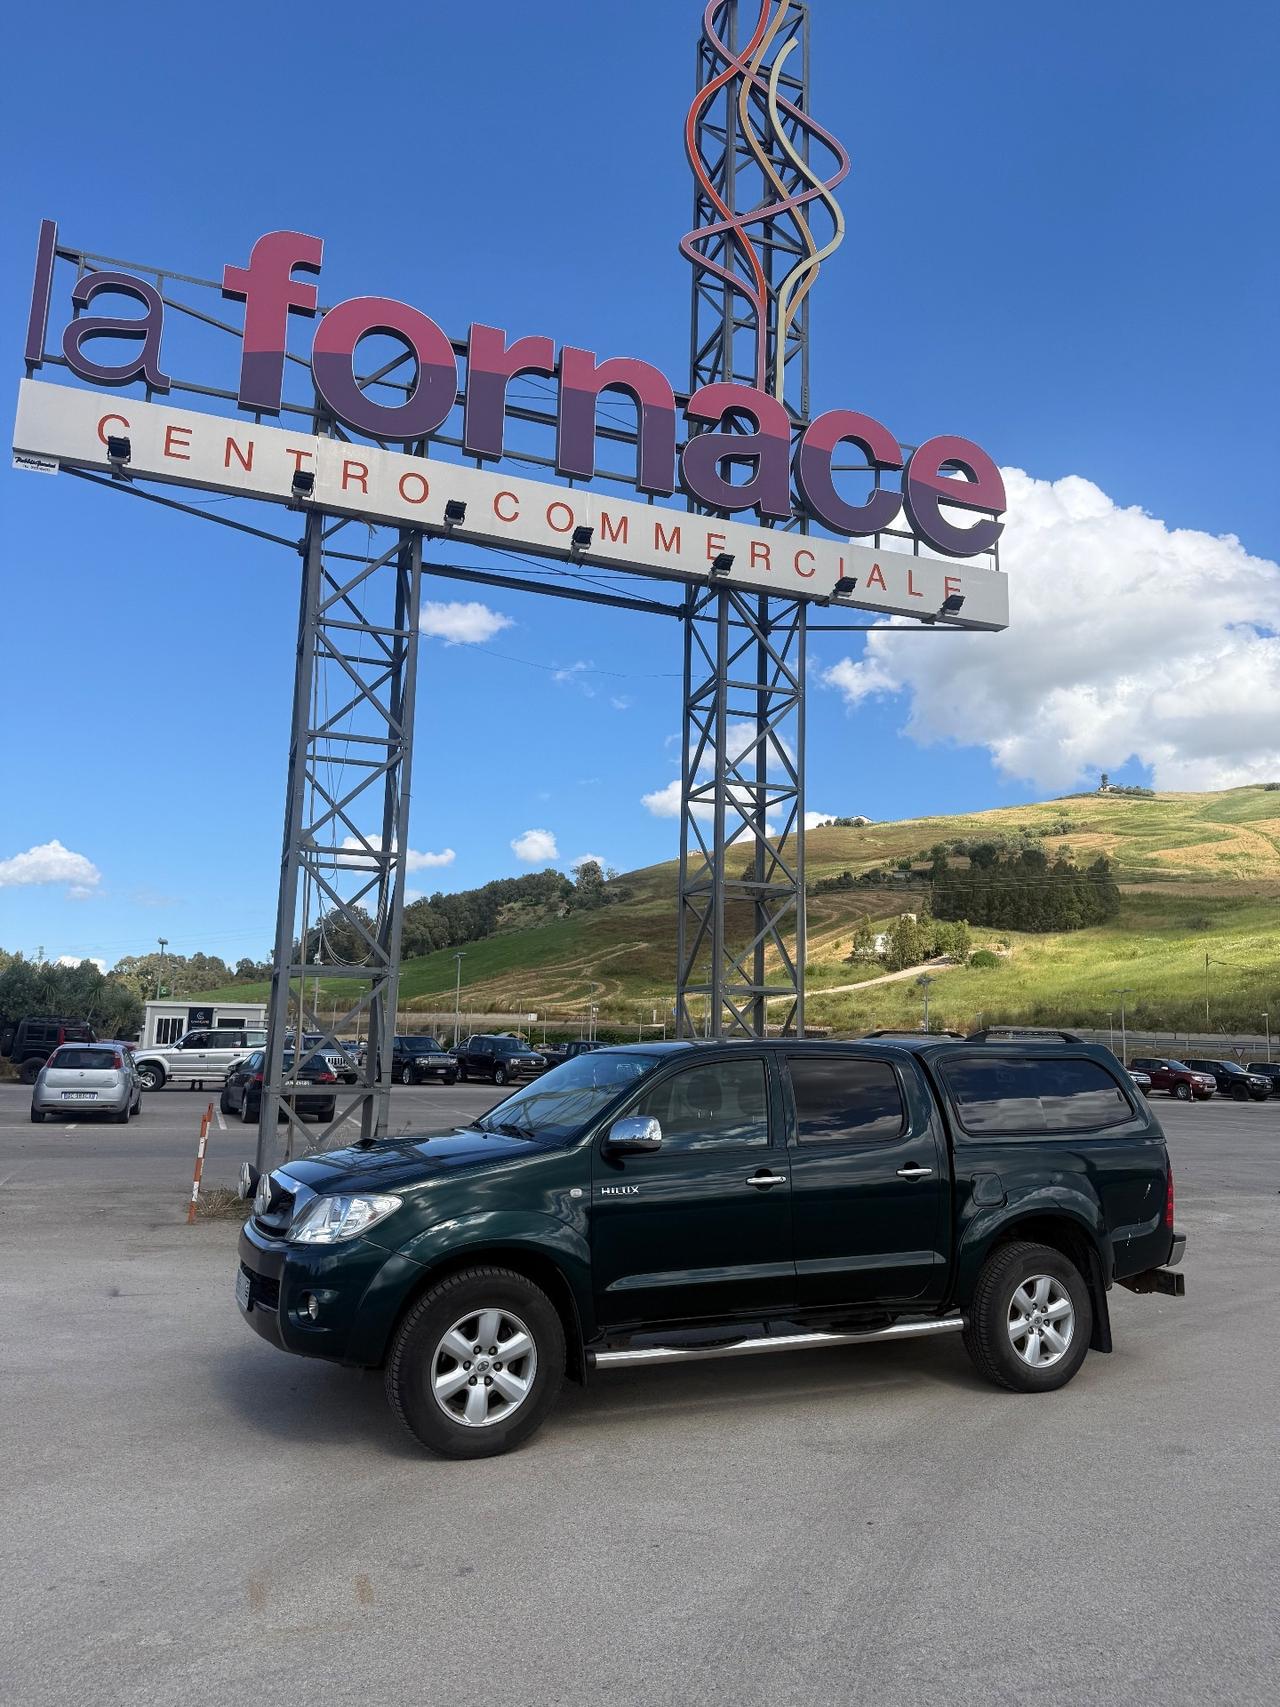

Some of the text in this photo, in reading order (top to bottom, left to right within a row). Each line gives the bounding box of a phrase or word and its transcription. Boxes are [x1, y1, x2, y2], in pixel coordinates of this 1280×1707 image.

[25, 218, 1007, 558] la fornace
[97, 413, 962, 601] CENTRO COMMERCIALE
[601, 1186, 639, 1195] HILUX
